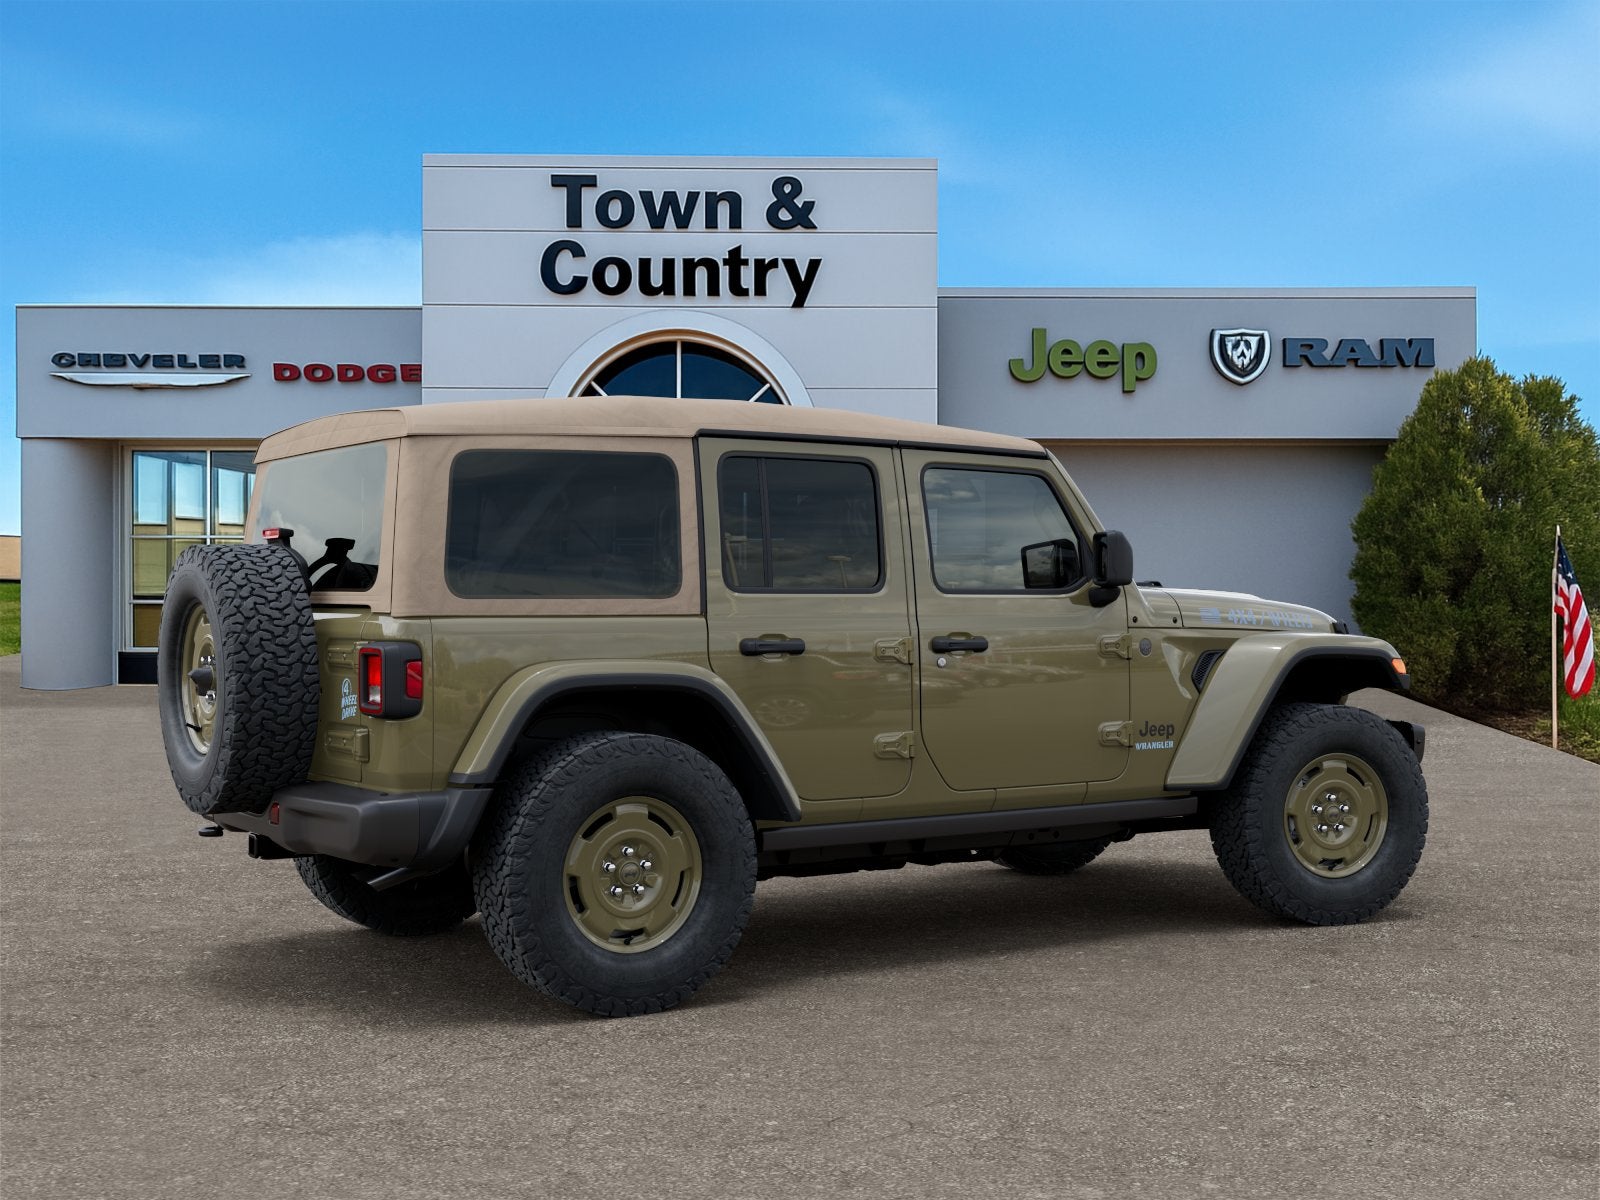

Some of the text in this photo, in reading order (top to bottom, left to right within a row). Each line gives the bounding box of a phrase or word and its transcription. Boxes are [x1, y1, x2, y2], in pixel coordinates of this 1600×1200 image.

[550, 174, 818, 230] Town &
[539, 239, 823, 308] Country
[1008, 327, 1158, 393] Jeep
[1282, 337, 1435, 368] RAM
[272, 362, 422, 383] DODGE
[1135, 740, 1174, 750] WRANGLER
[1139, 720, 1175, 739] Jeep
